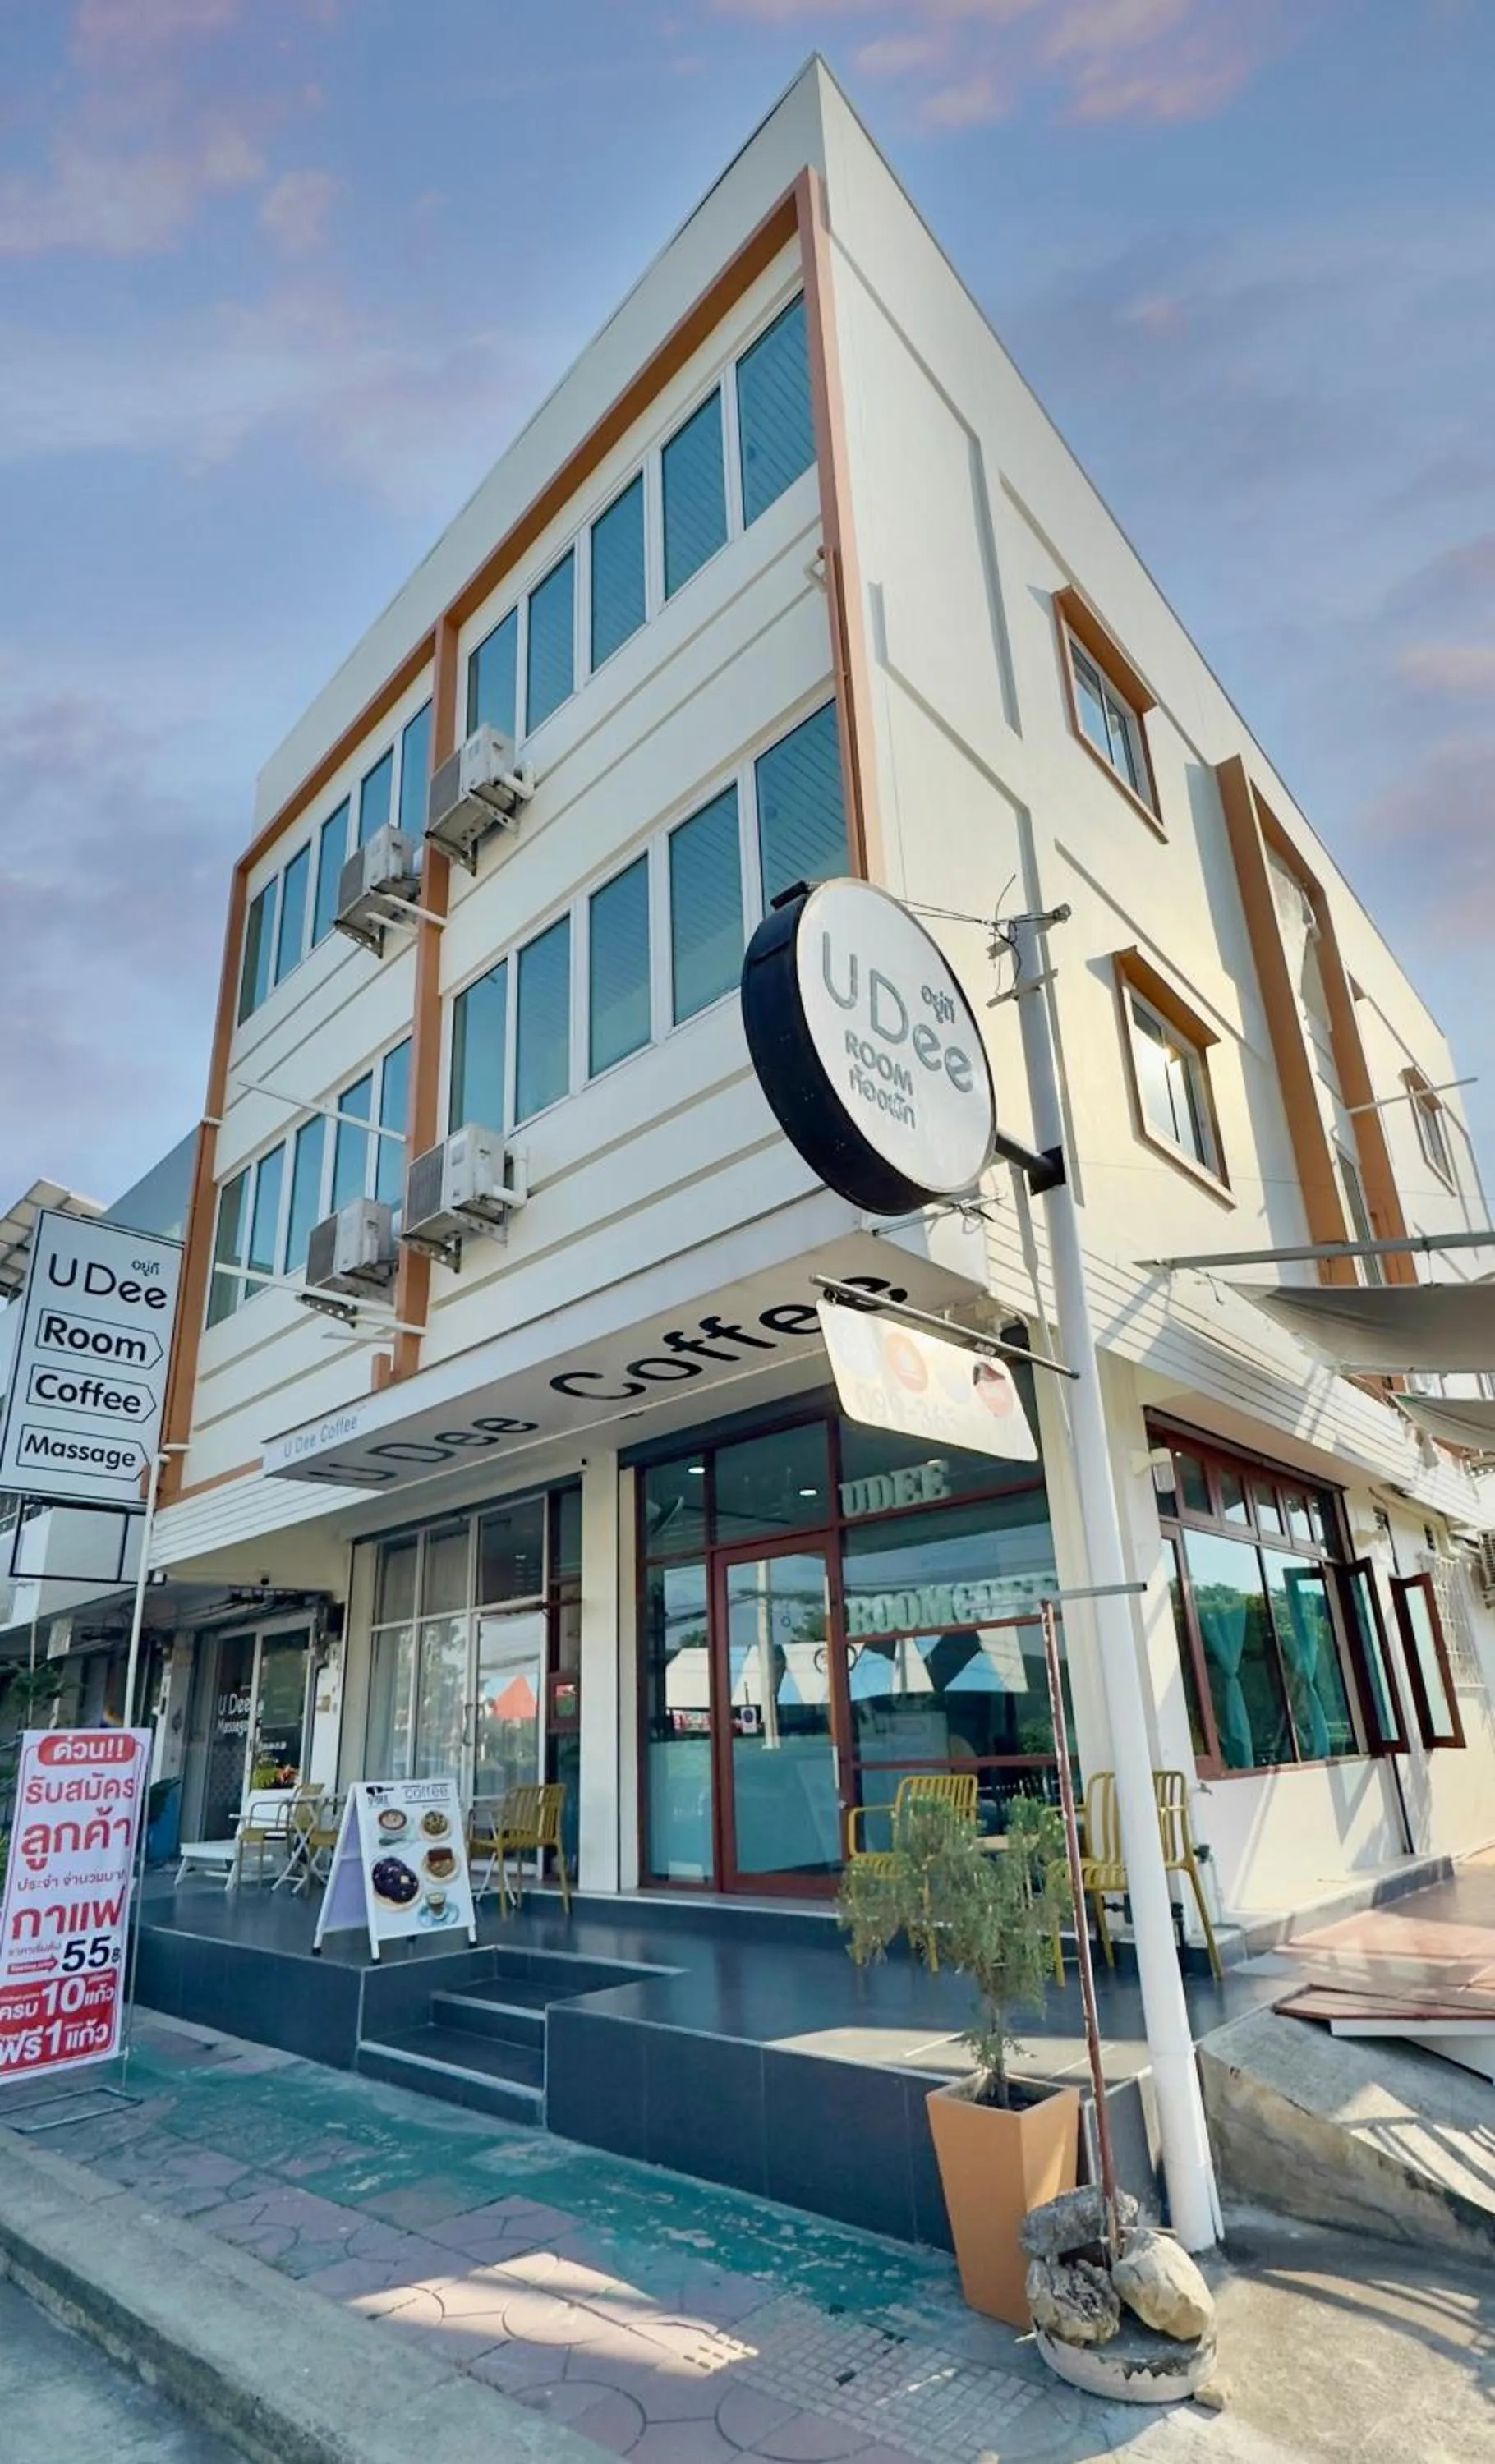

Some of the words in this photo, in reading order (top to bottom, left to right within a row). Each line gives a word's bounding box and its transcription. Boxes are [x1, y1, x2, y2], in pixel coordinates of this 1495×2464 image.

[844, 1029, 913, 1096] ROOM
[43, 1316, 147, 1361] Room
[35, 1374, 142, 1414] Coffee
[25, 1433, 136, 1469] Massage
[838, 1460, 951, 1519] UDEE
[25, 1772, 135, 1804] รับสมัคร
[21, 1806, 131, 1871] ลูกค้า
[12, 1884, 126, 1941] กาแฟ
[41, 1977, 86, 2016] 10
